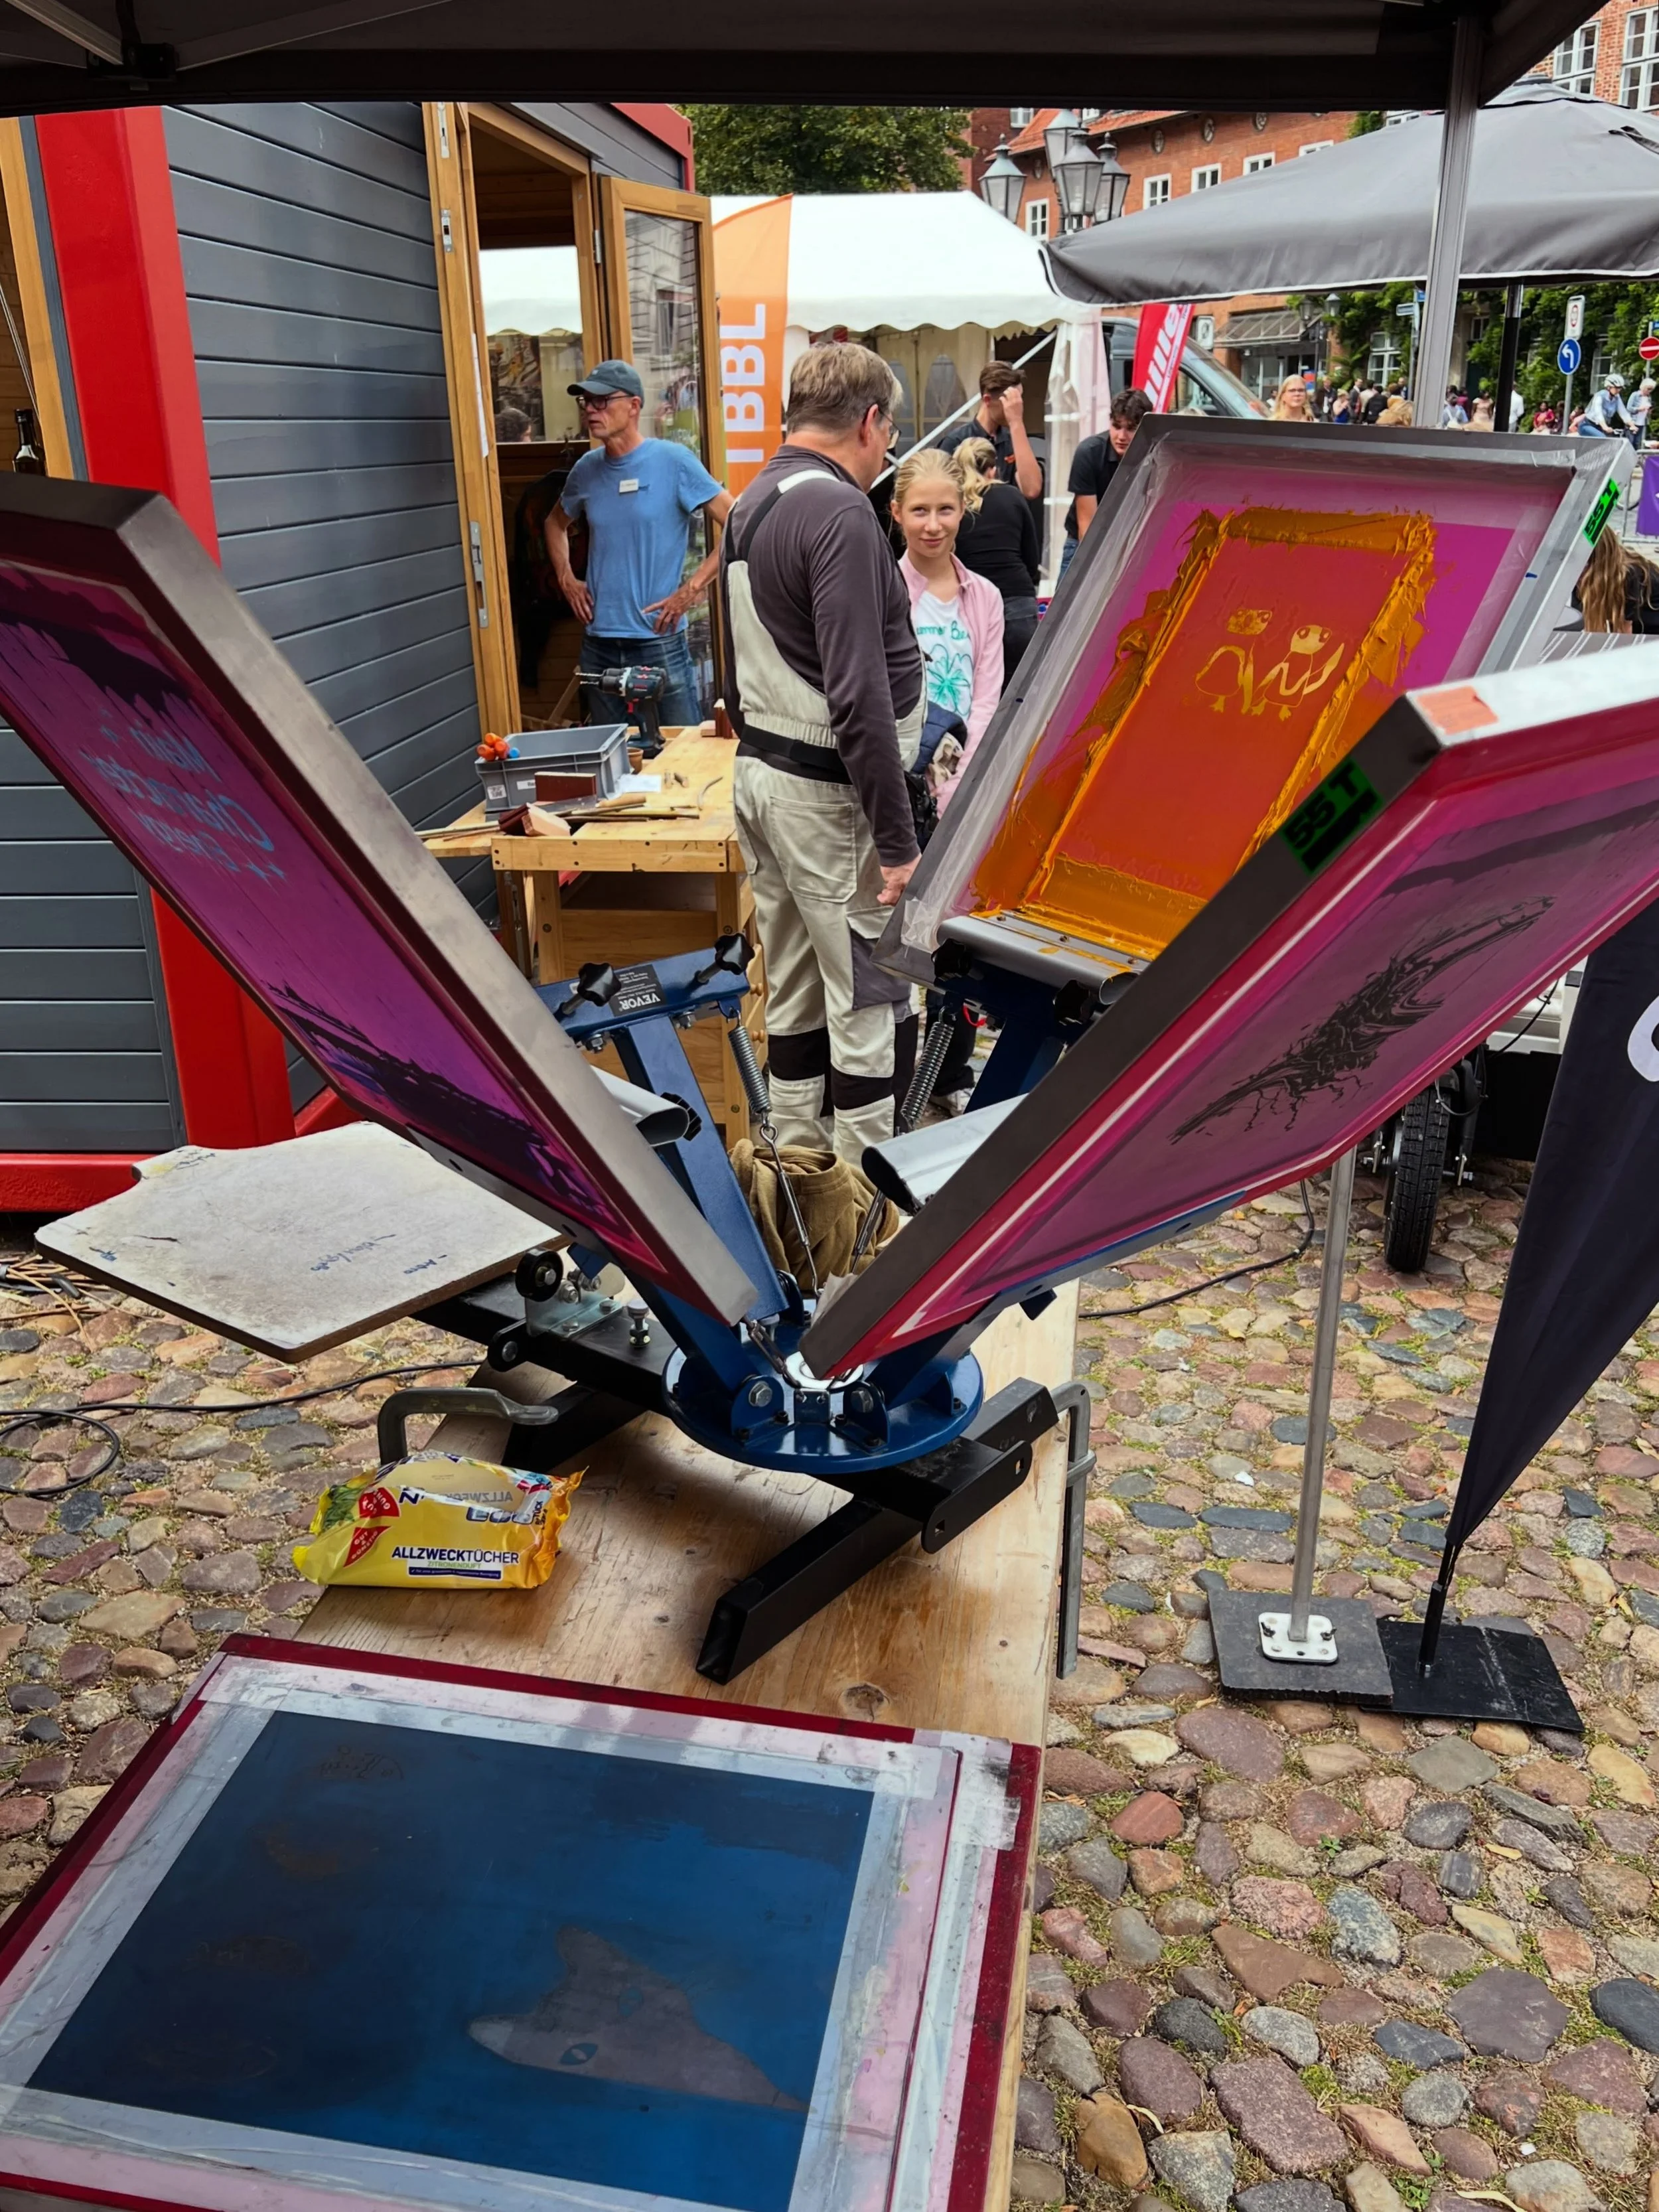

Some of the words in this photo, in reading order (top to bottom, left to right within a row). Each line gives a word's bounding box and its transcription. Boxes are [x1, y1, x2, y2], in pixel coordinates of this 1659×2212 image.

[720, 303, 766, 463] IBBL
[619, 993, 661, 1010] VEVOR
[392, 1546, 519, 1564] ALLZWECKTÜCHER
[427, 1560, 482, 1569] ZITRONENDUFT
